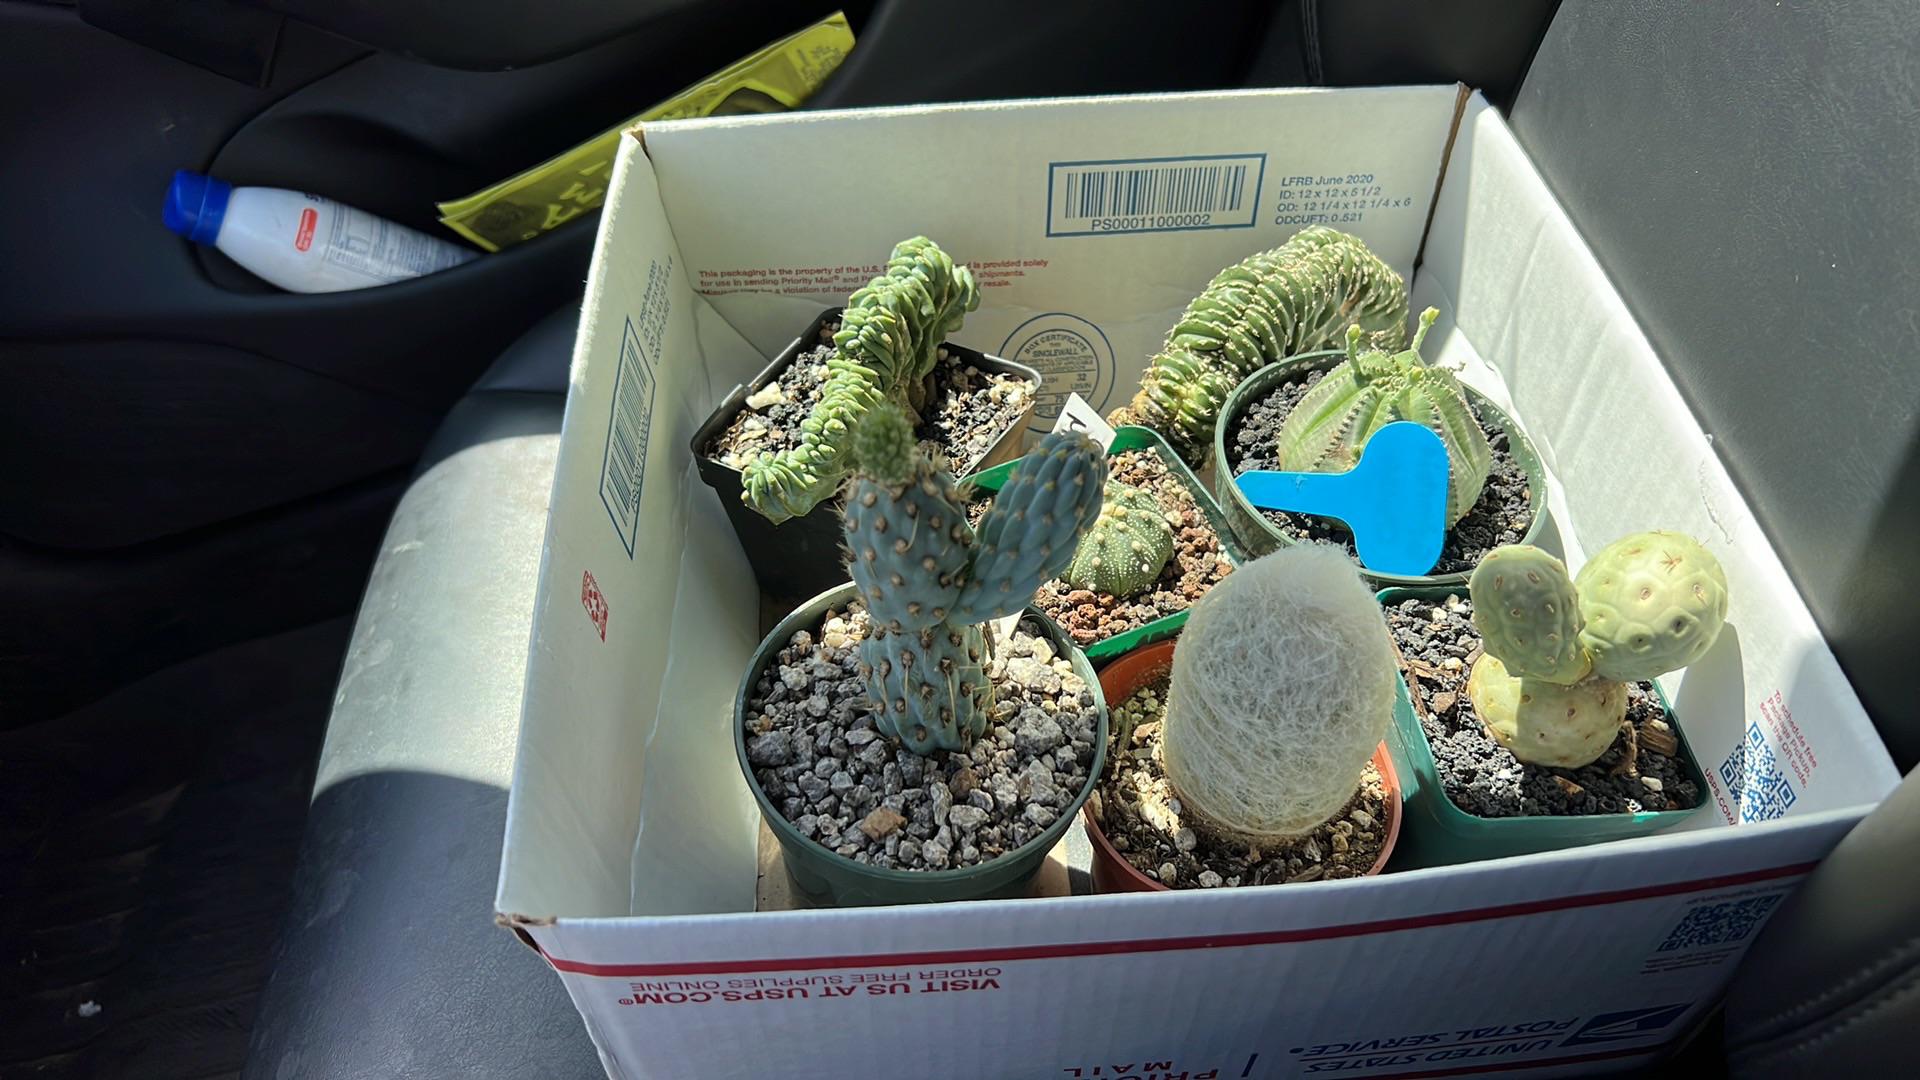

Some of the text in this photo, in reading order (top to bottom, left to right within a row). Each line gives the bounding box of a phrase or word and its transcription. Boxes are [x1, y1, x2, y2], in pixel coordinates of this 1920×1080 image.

[1281, 174, 1374, 187] LFRB June 2020
[1279, 190, 1295, 200] ID:
[1299, 189, 1312, 199] 12
[1325, 188, 1338, 198] 12
[1361, 186, 1381, 197] 1/2
[1277, 203, 1299, 213] OD:
[1303, 202, 1317, 211] 12
[1320, 201, 1339, 211] 1/4
[1353, 200, 1366, 210] 12
[1370, 198, 1389, 209] 1/4
[1403, 197, 1412, 207] 6
[1091, 214, 1211, 232] PS00011000002
[1331, 212, 1363, 223] 0.521
[700, 270, 718, 279] This
[721, 268, 767, 279] packaging
[768, 269, 776, 277] is
[778, 268, 793, 276] the
[795, 266, 833, 277] property
[835, 266, 844, 274] of
[846, 266, 860, 274] the
[862, 265, 881, 273] U.S.
[983, 260, 1021, 270] provided
[1023, 259, 1049, 268] solely
[700, 280, 713, 288] for
[734, 279, 742, 287] in
[744, 277, 779, 287] sending
[781, 277, 813, 287] Priority
[842, 276, 859, 284] and
[783, 286, 819, 295] violation
[822, 286, 830, 294] of
[1041, 333, 1088, 353] CERTIFICATE
[1768, 697, 1791, 740] Package
[1774, 689, 1817, 769] To schedule free
[1759, 702, 1808, 789] scan the QR code.
[630, 967, 1001, 992] ORDER FREE SUPPLIES ONLINE
[920, 978, 1001, 993] VISIT
[818, 985, 857, 998] AT
[867, 982, 911, 996] US
[1456, 1016, 1579, 1041] POSTAL
[1303, 1038, 1554, 1074] UNITED STATES
[1063, 1060, 1173, 1077] MAIL
